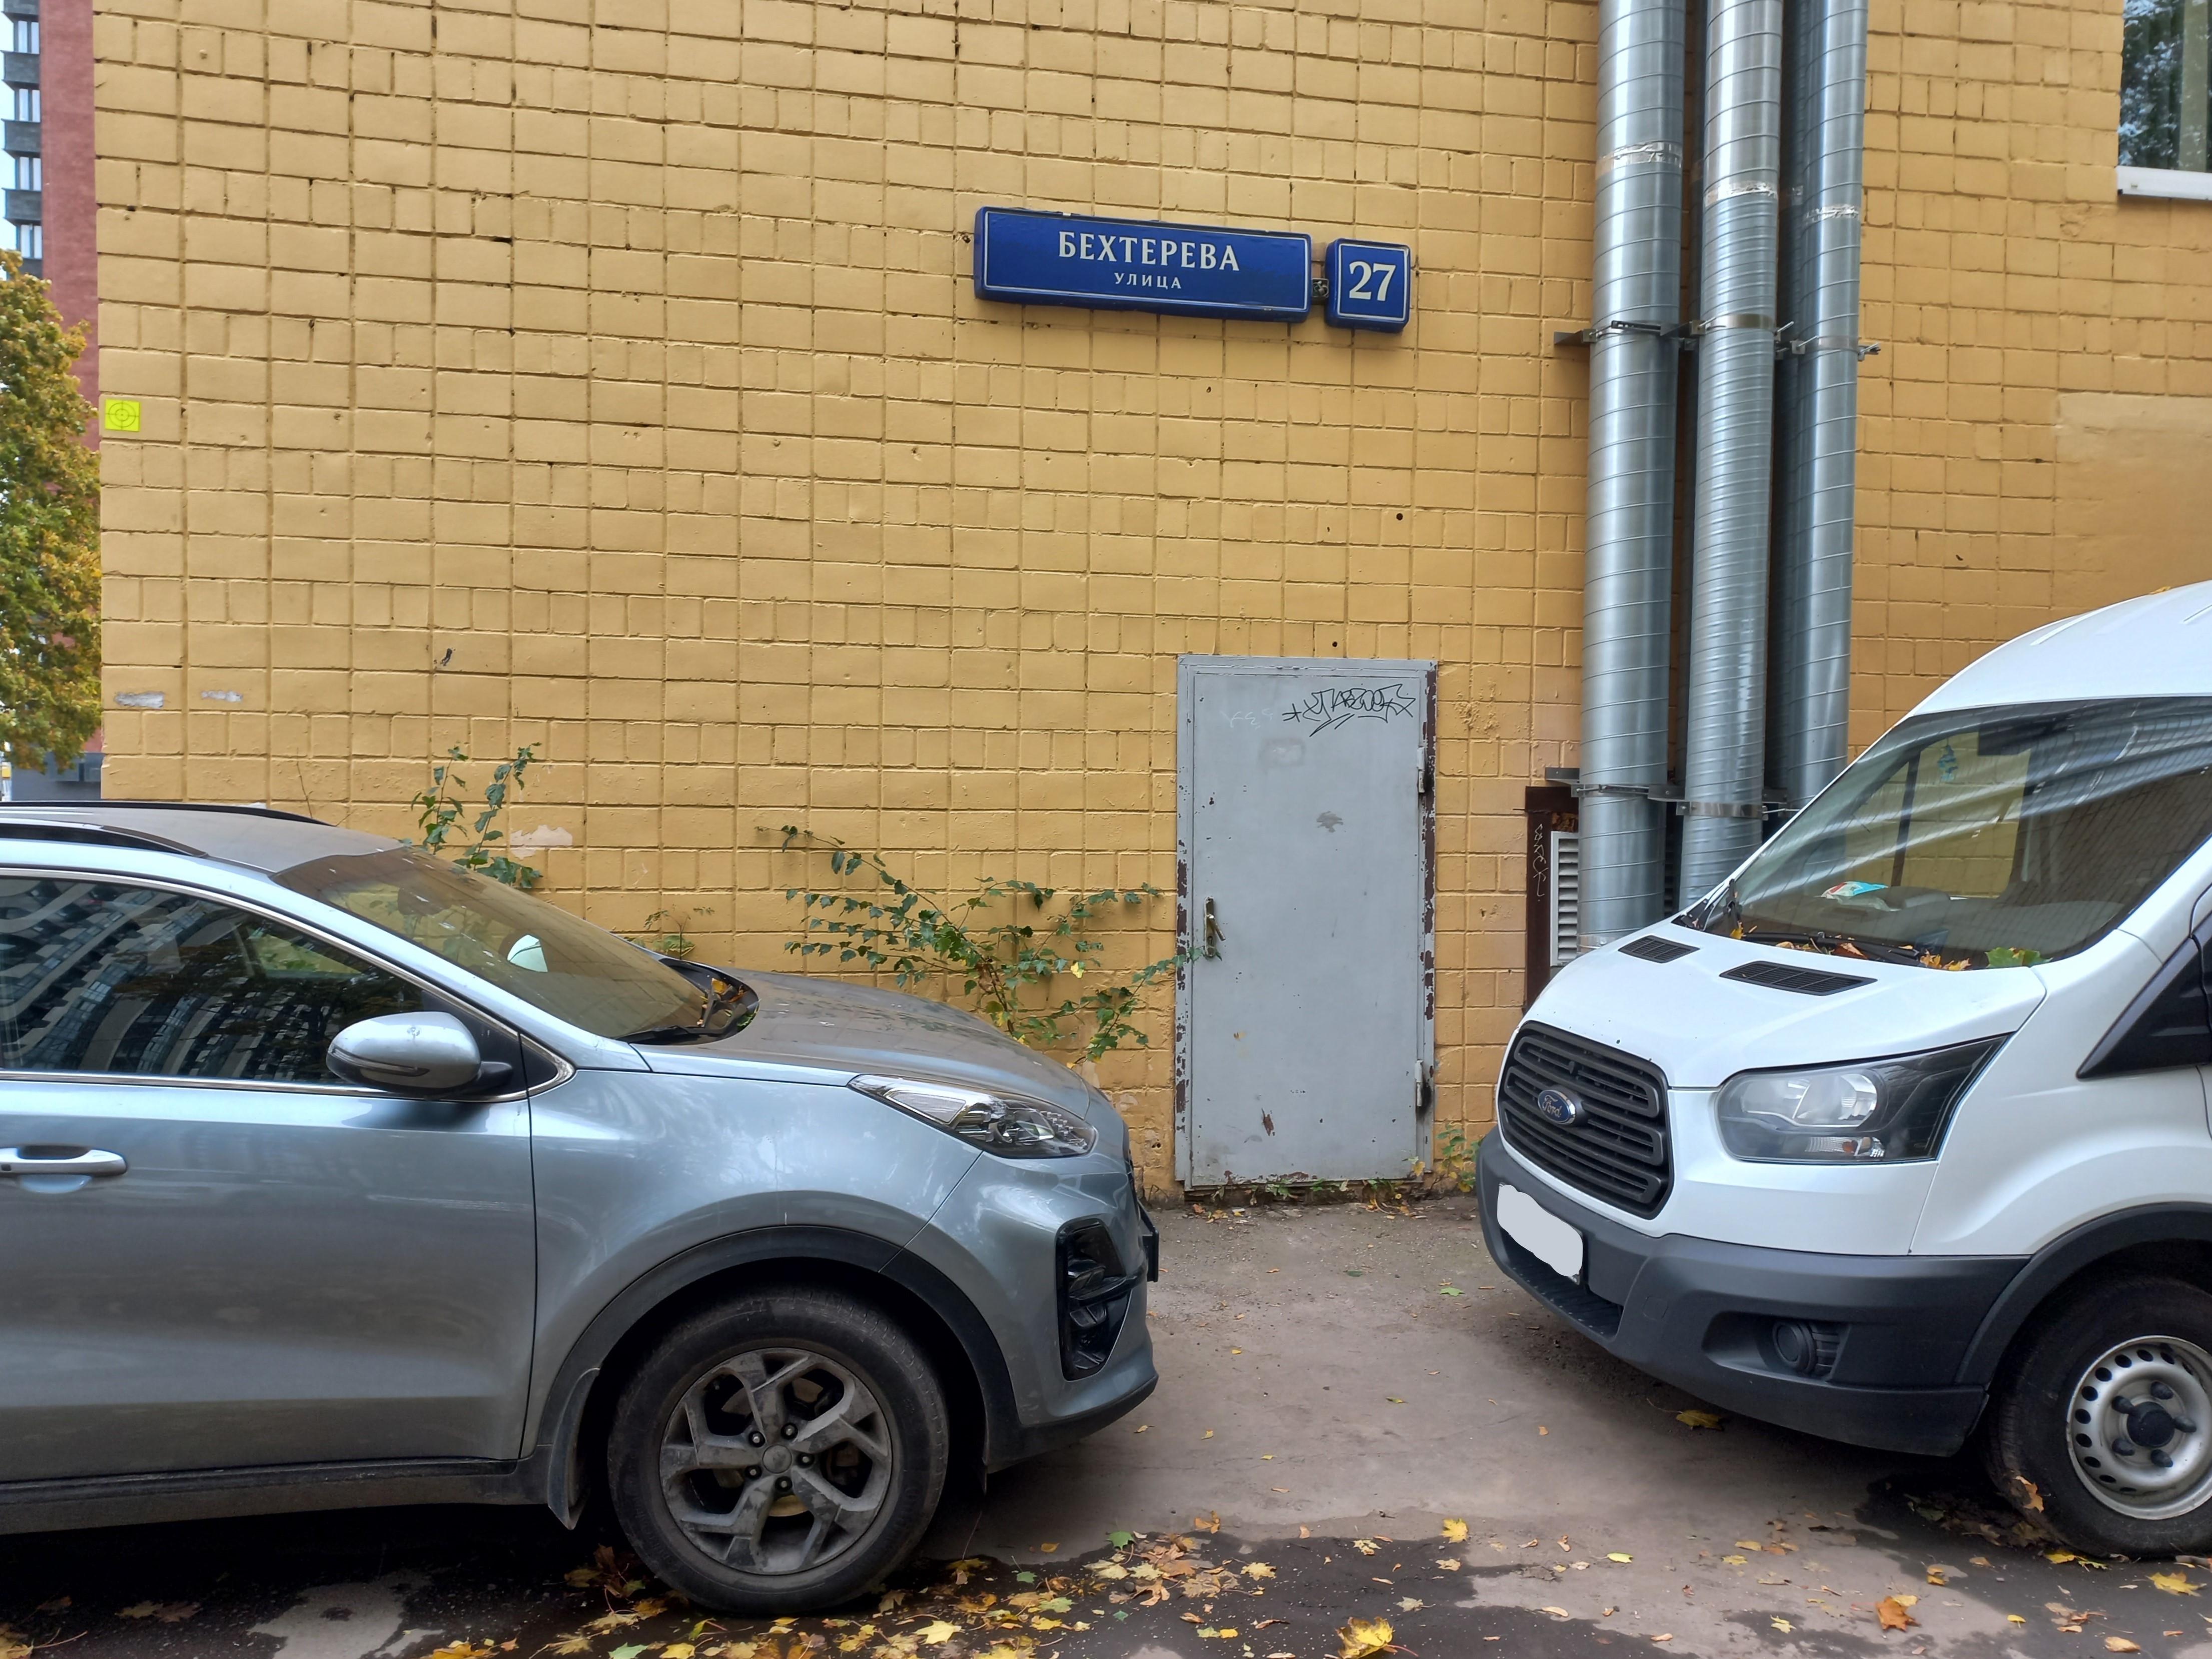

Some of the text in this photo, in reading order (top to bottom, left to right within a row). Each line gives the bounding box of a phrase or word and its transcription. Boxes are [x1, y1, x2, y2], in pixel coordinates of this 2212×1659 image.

[1059, 231, 1240, 271] БЕХТЕРЕВА
[1114, 272, 1182, 289] УЛИЦА
[1349, 261, 1396, 301] 27
[1542, 1094, 1563, 1118] Ford
